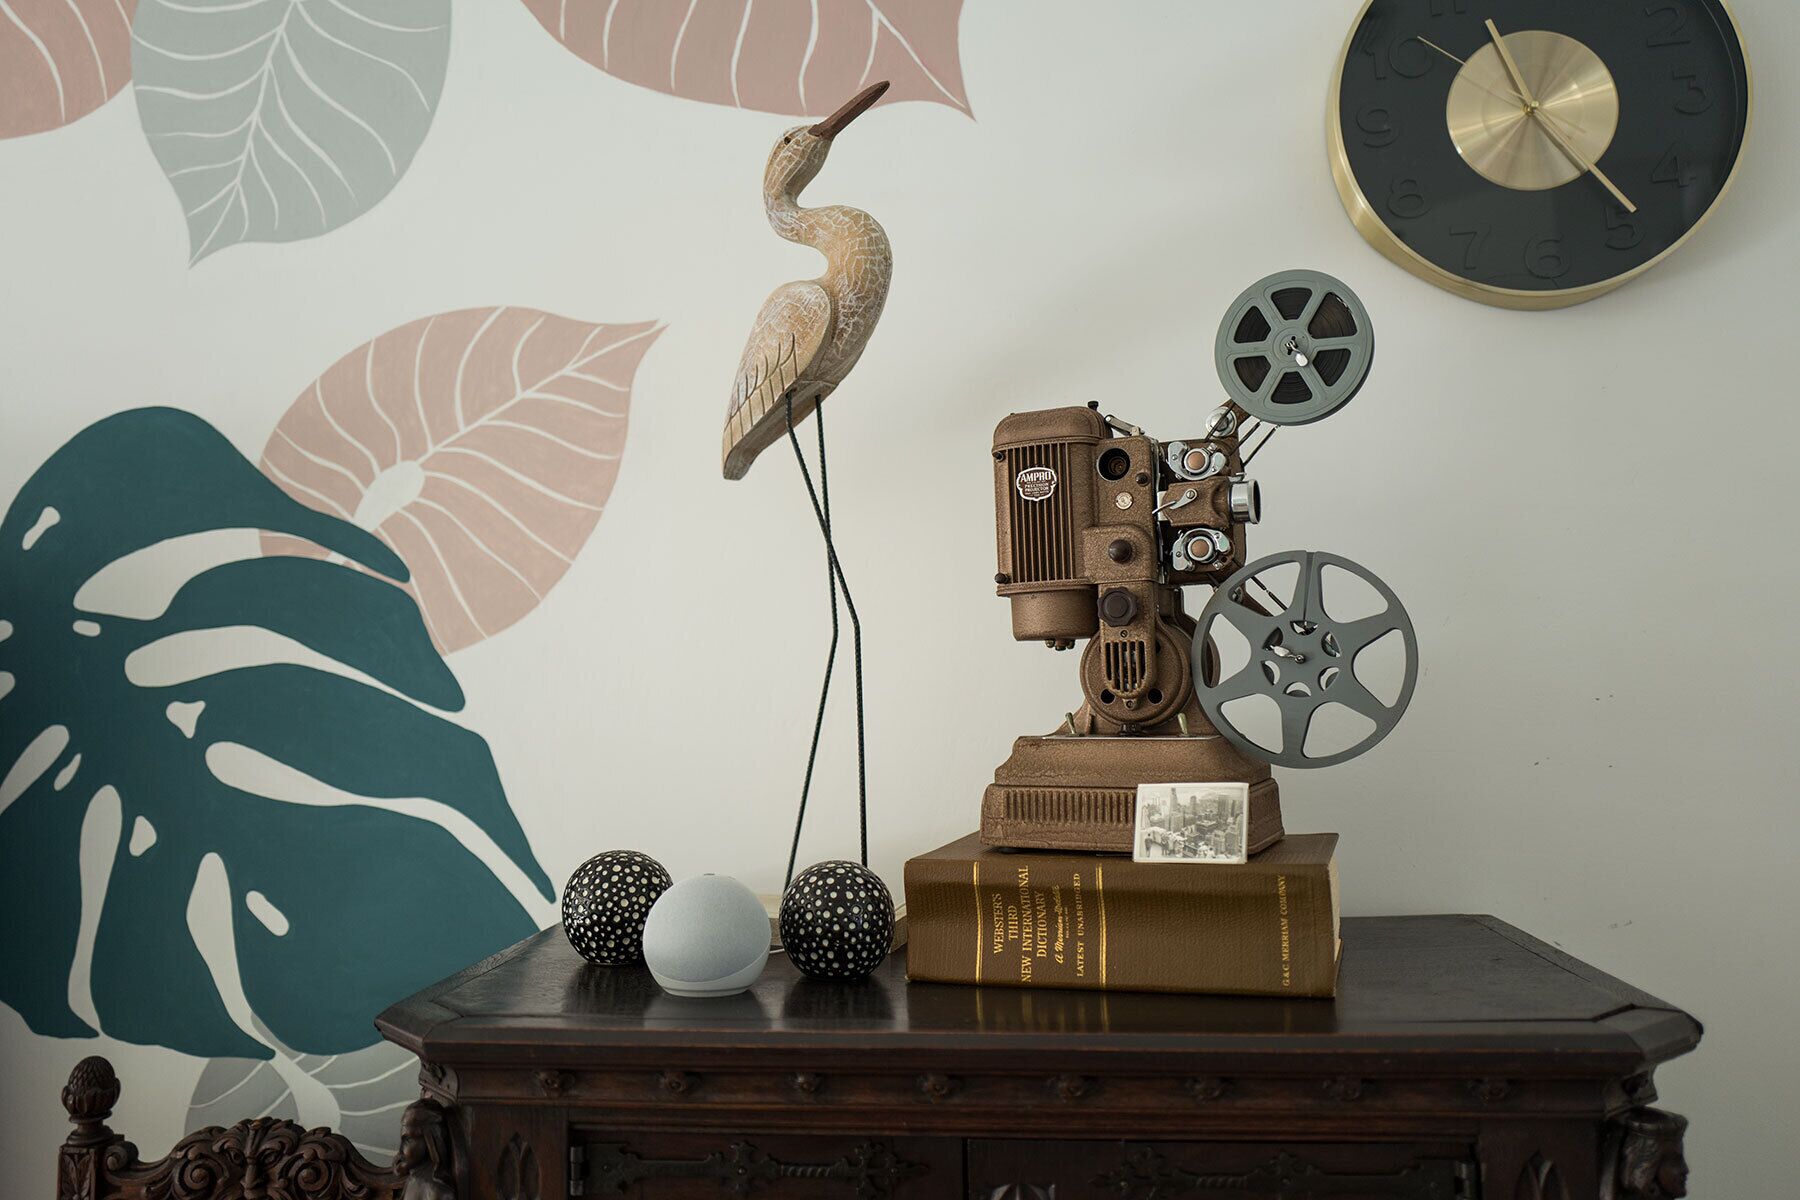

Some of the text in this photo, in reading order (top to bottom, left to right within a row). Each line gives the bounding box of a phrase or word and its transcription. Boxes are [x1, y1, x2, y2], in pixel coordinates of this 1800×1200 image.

[1643, 1, 1691, 48] 2
[1363, 32, 1434, 81] 10
[1671, 70, 1716, 116] 3
[1354, 102, 1401, 149] 9
[1648, 142, 1697, 189] 4
[1385, 174, 1432, 220] 8
[1448, 222, 1492, 271] 7
[1601, 203, 1647, 251] 5
[1523, 232, 1574, 280] 6
[1020, 471, 1051, 482] AMPRO
[1278, 875, 1288, 915] COMPANY
[993, 893, 1004, 954] WEBSTER'S
[1008, 905, 1018, 941] THIRD
[1018, 865, 1032, 983] NEW INTERNATIONAL
[1035, 891, 1047, 958] DICTIONARY
[1073, 873, 1085, 977] LATEST UNABRIDGED
[1280, 918, 1290, 962] MERRIAM
